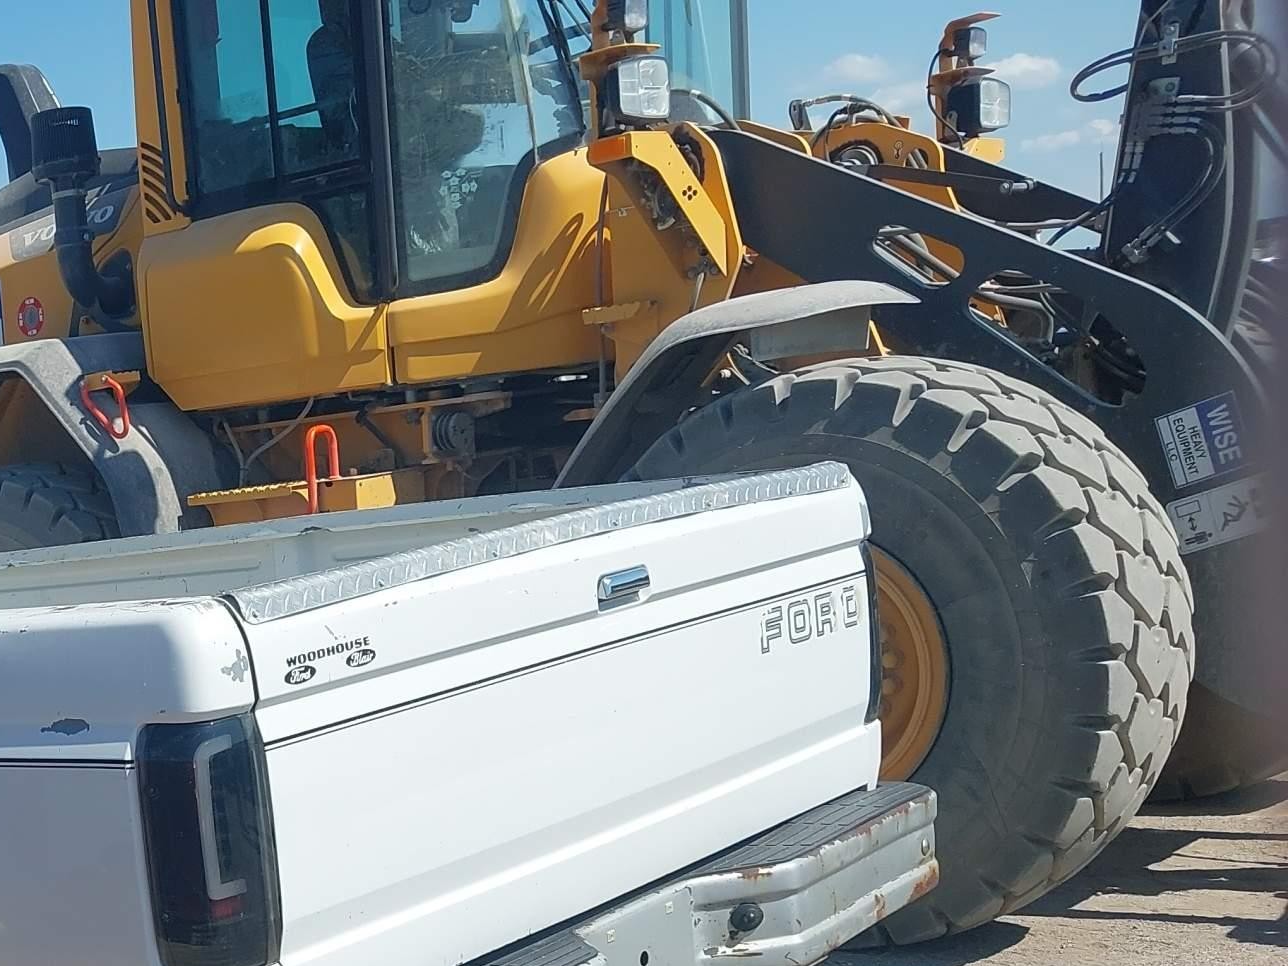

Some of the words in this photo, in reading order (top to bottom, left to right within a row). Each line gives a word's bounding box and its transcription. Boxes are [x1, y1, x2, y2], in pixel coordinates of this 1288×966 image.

[1172, 417, 1199, 474] EQUIPMENT
[1188, 426, 1207, 459] HEAVY
[1207, 403, 1241, 464] WISE
[1165, 442, 1178, 462] LLC
[759, 586, 861, 655] FORD
[286, 636, 371, 667] WOODHOUSE
[348, 649, 375, 667] Blair
[288, 666, 314, 684] Ford
